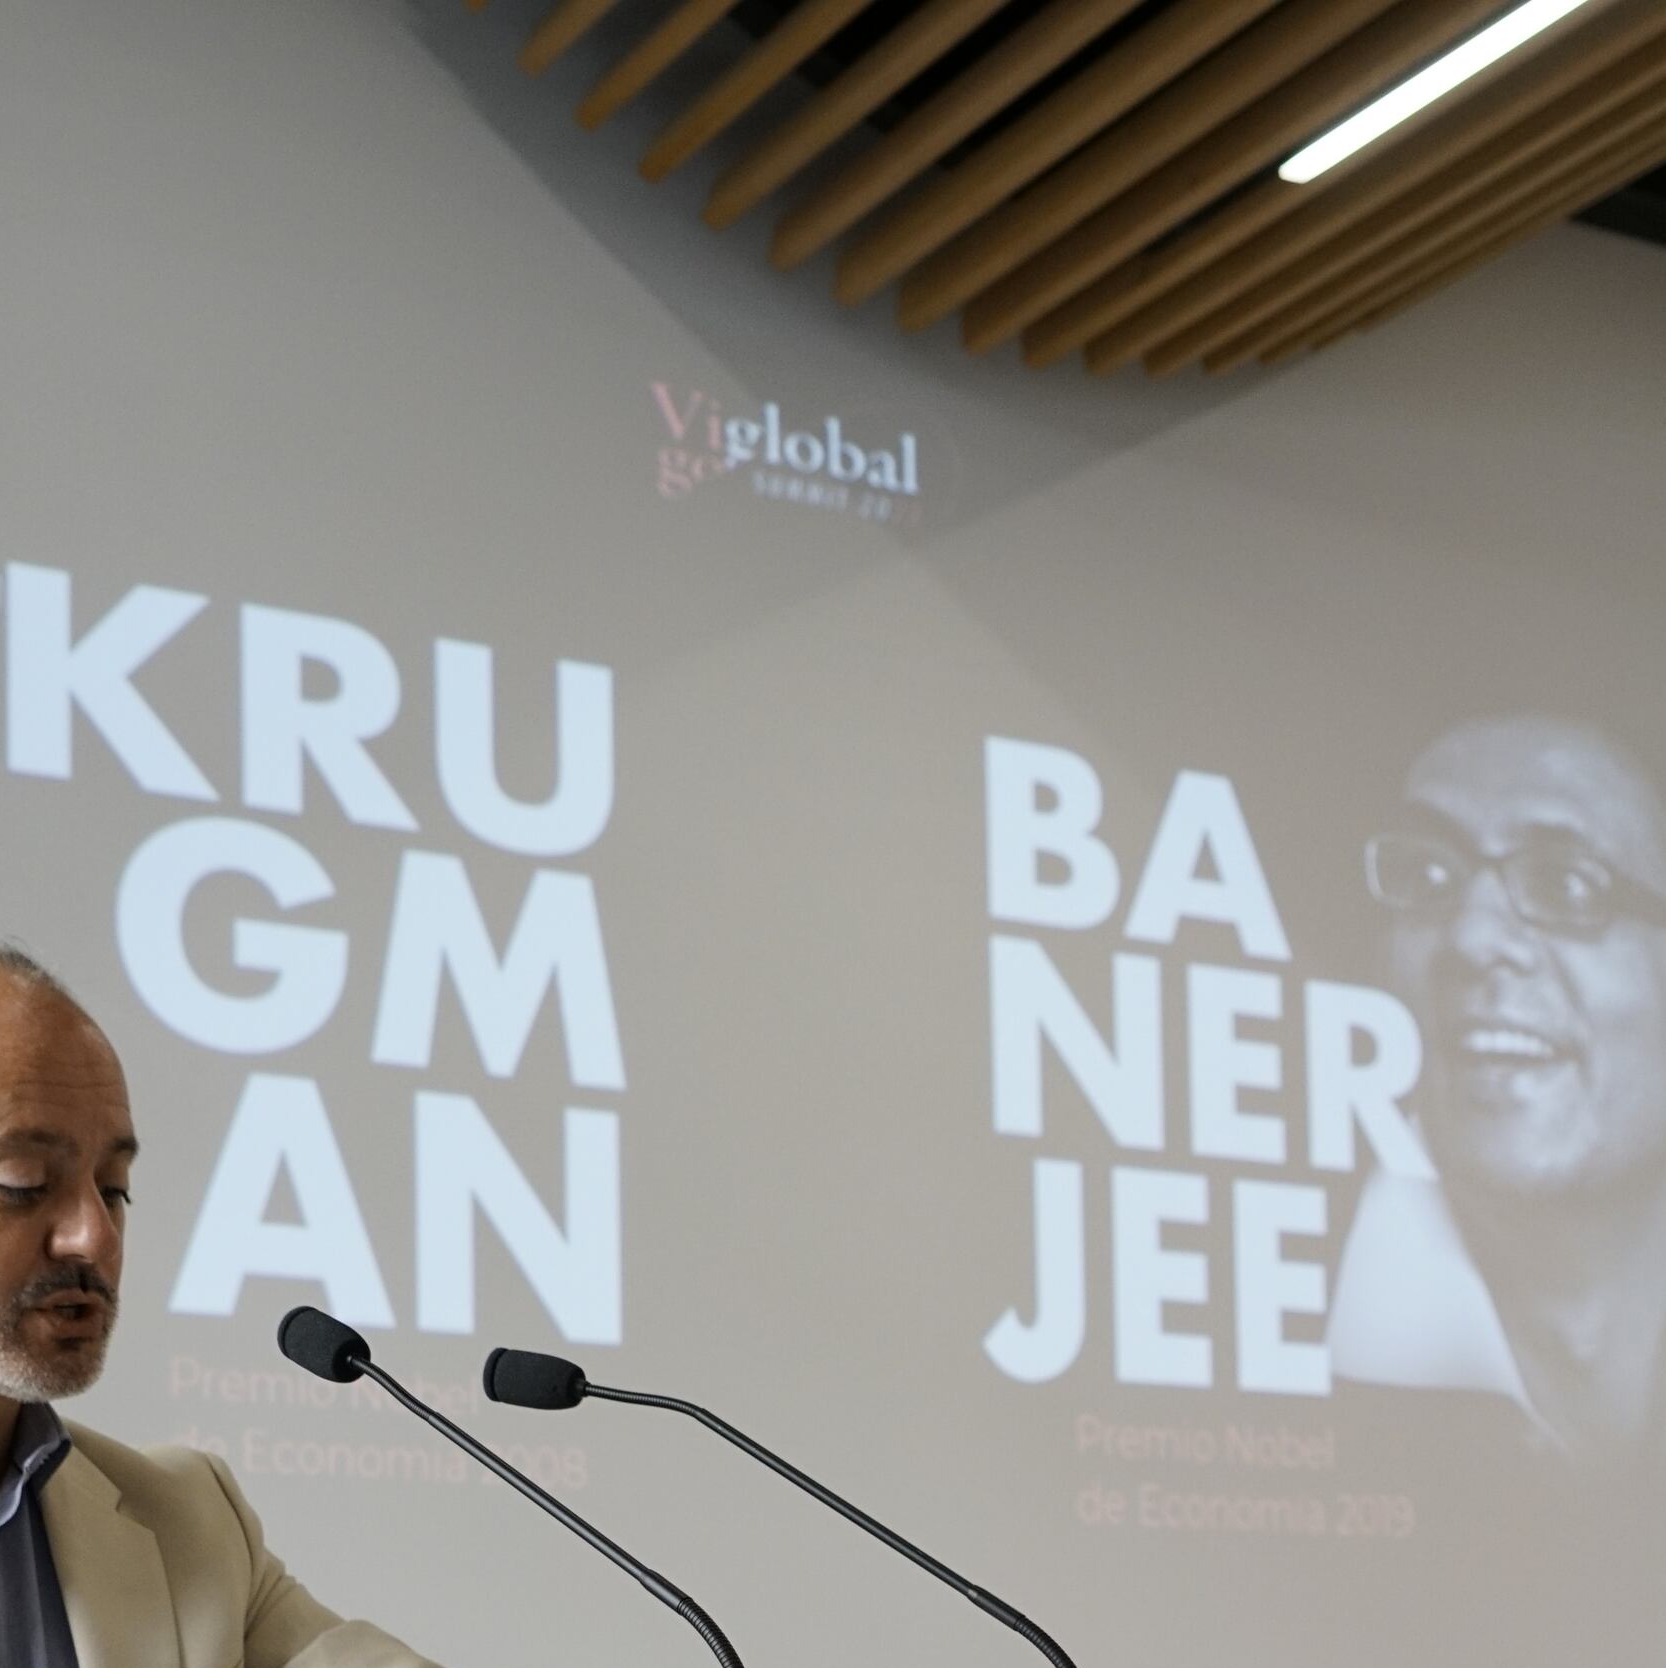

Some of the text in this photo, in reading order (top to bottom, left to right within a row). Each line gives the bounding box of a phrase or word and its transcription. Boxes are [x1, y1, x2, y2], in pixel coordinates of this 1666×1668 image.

[5, 560, 614, 857] KRU
[114, 815, 627, 1092] GM
[984, 733, 1293, 962] BA
[988, 933, 1439, 1182] NER
[167, 1071, 623, 1345] AN
[981, 1158, 1332, 1398] JEE
[171, 1355, 337, 1408] Premio
[1074, 1412, 1337, 1471] Premio Nobel
[1075, 1479, 1129, 1527] de
[1335, 1490, 1417, 1538] 2019
